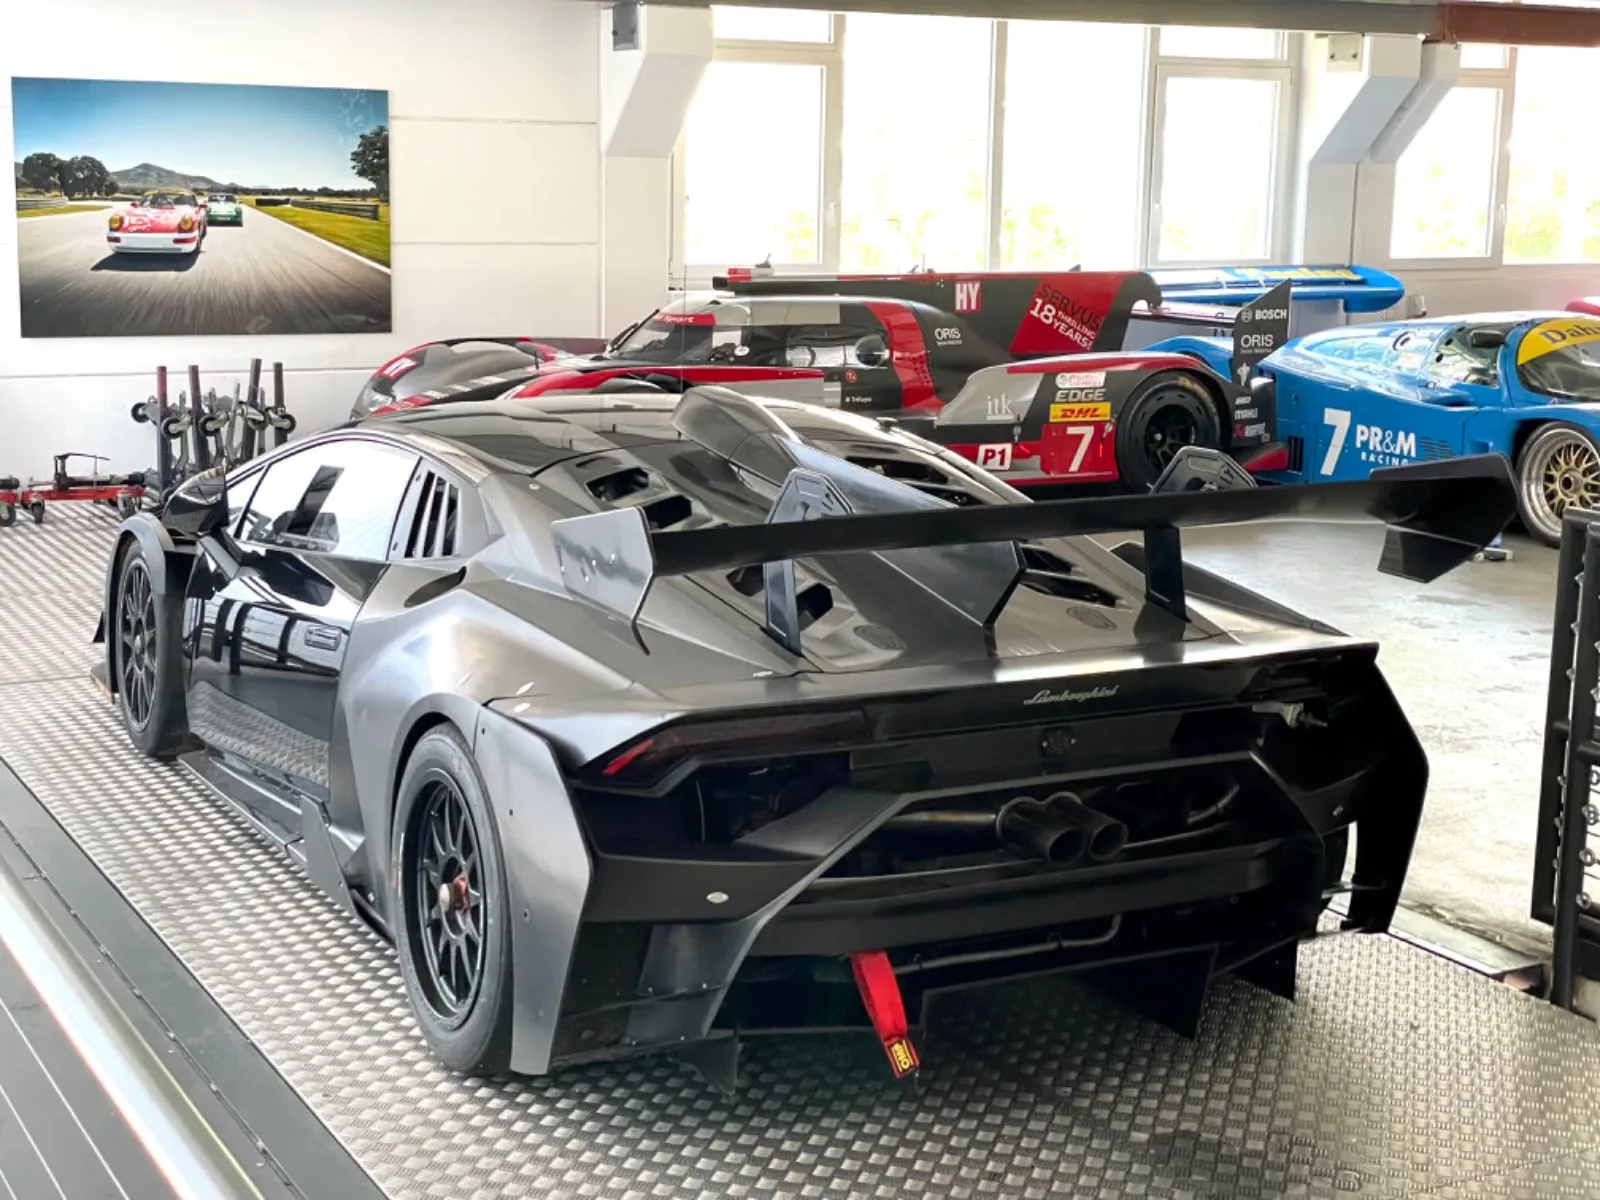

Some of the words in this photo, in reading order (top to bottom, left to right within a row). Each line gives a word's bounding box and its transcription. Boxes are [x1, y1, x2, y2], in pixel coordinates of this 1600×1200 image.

[955, 283, 980, 310] HY
[1040, 283, 1102, 330] SERVUS
[1029, 297, 1057, 324] 18
[1254, 308, 1287, 320] BOSCH
[934, 327, 961, 341] ORIS
[1052, 318, 1093, 350] YEARS!
[1056, 310, 1096, 339] THRILLING
[1539, 324, 1600, 344] Dah
[1240, 334, 1274, 348] ORIS
[1055, 388, 1107, 403] EDGE
[1060, 407, 1101, 419] DHL
[1066, 425, 1094, 473] 7
[1320, 407, 1351, 476] 7
[1355, 424, 1416, 458] PR&M
[982, 448, 1006, 466] P1
[1361, 452, 1408, 466] RACING
[1023, 685, 1120, 705] Lamborghini
